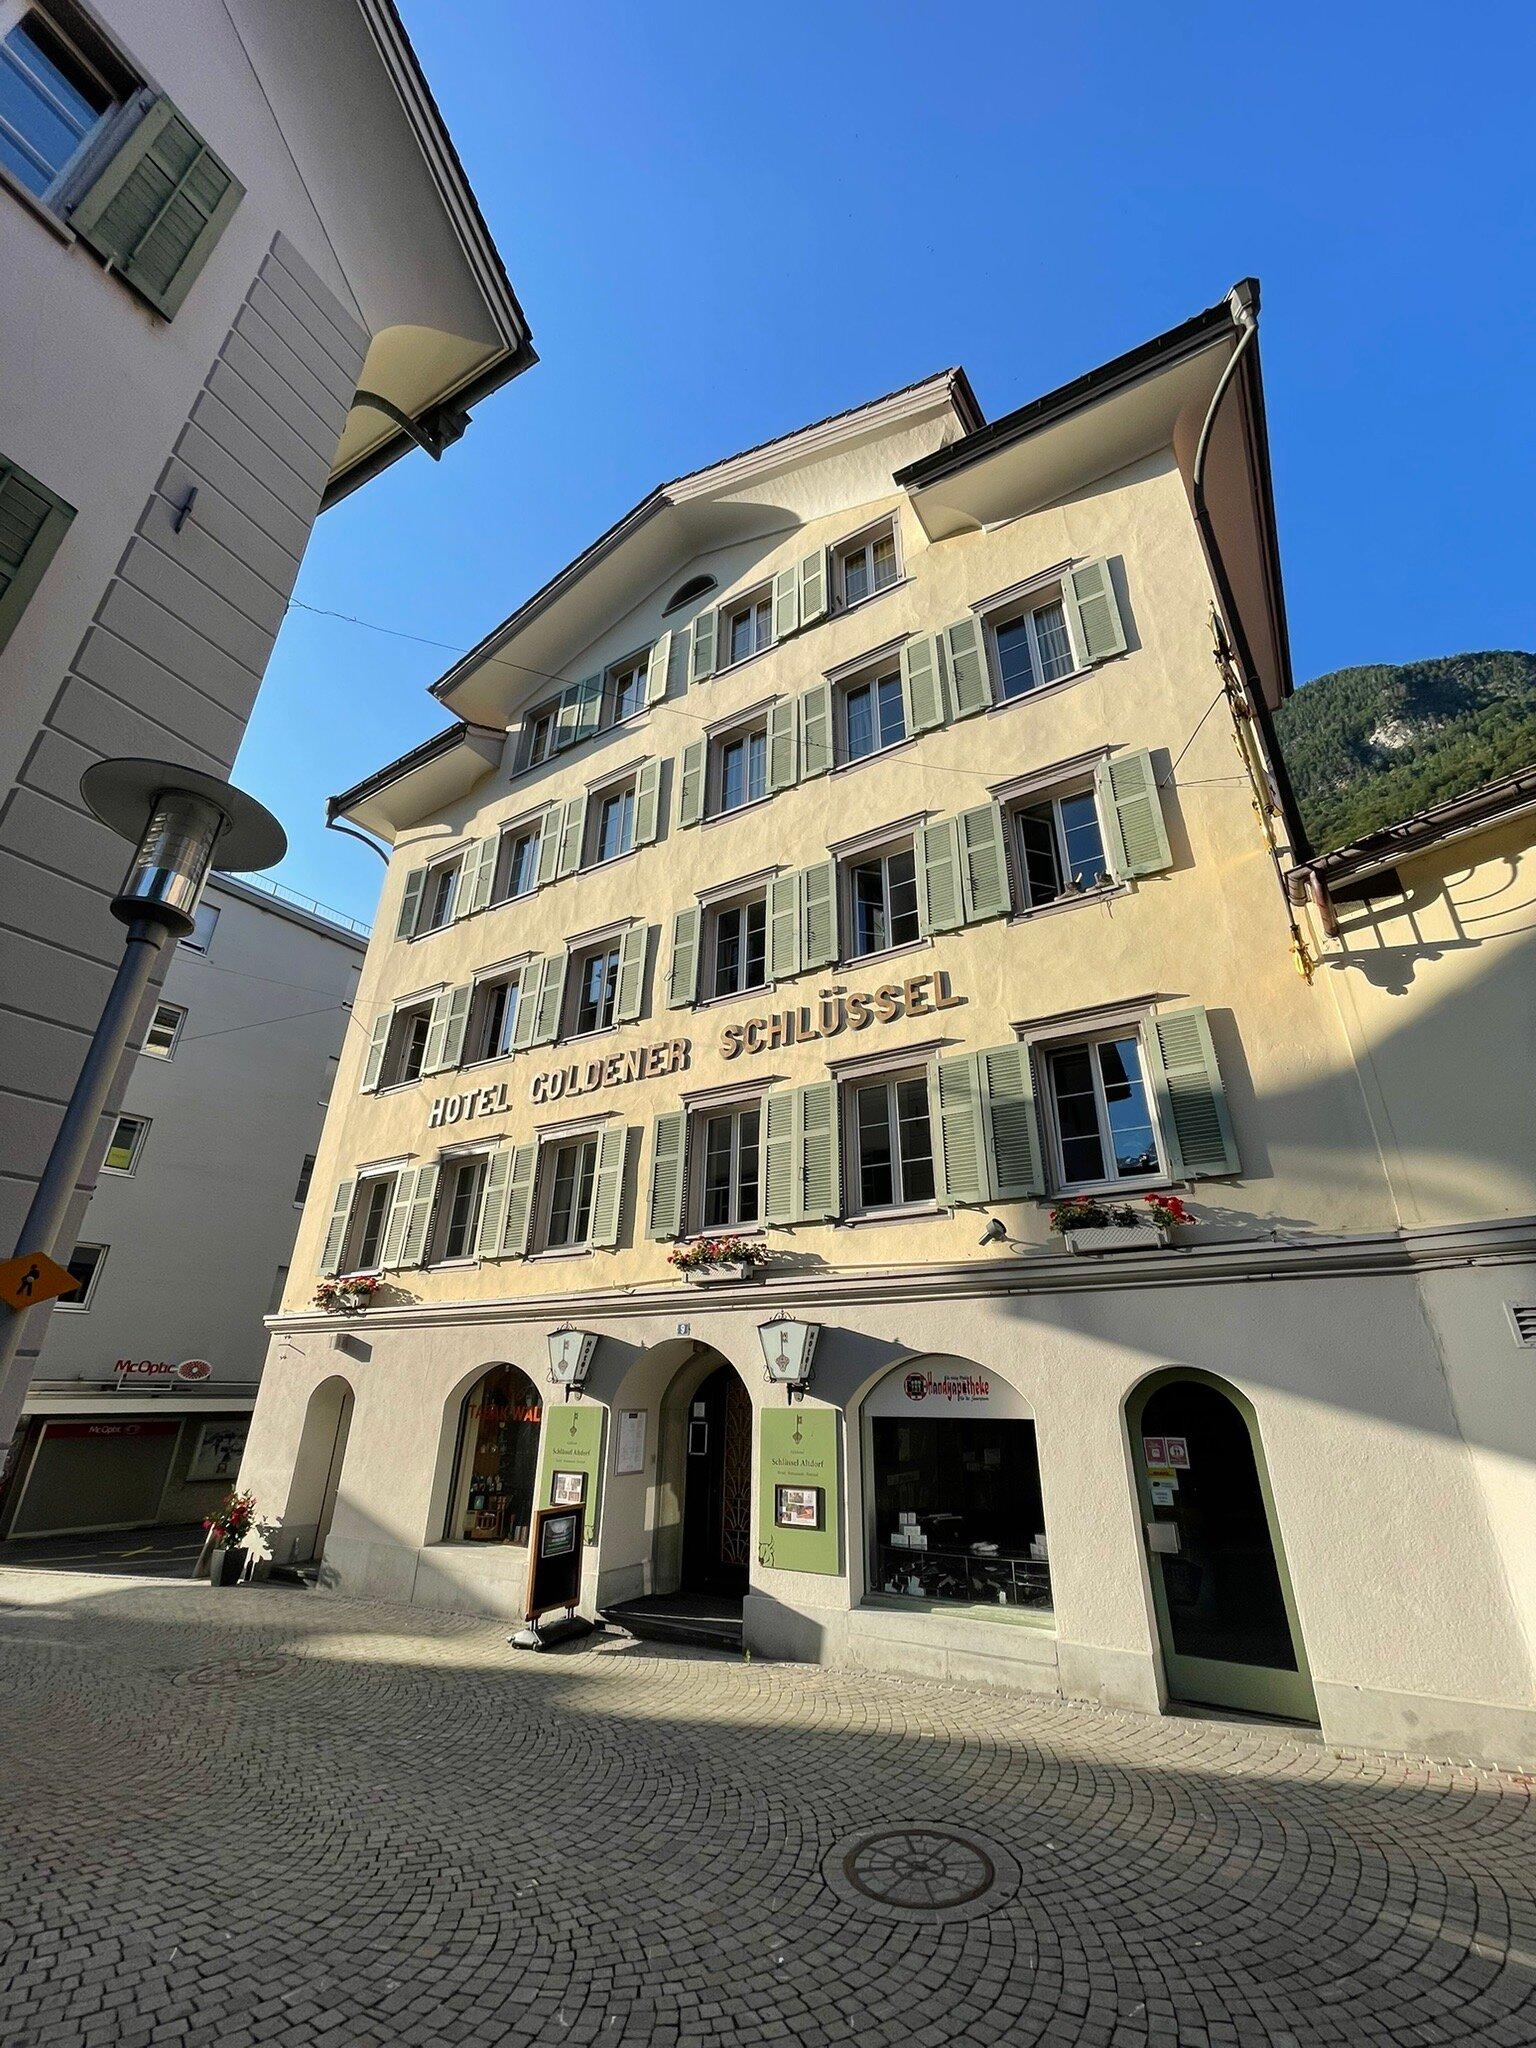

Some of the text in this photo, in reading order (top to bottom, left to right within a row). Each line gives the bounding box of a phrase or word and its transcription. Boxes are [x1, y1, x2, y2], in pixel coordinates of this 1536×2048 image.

[428, 970, 968, 1128] HOTEL GOLDENER SCHLÜSSEL
[114, 1360, 176, 1375] McOptic
